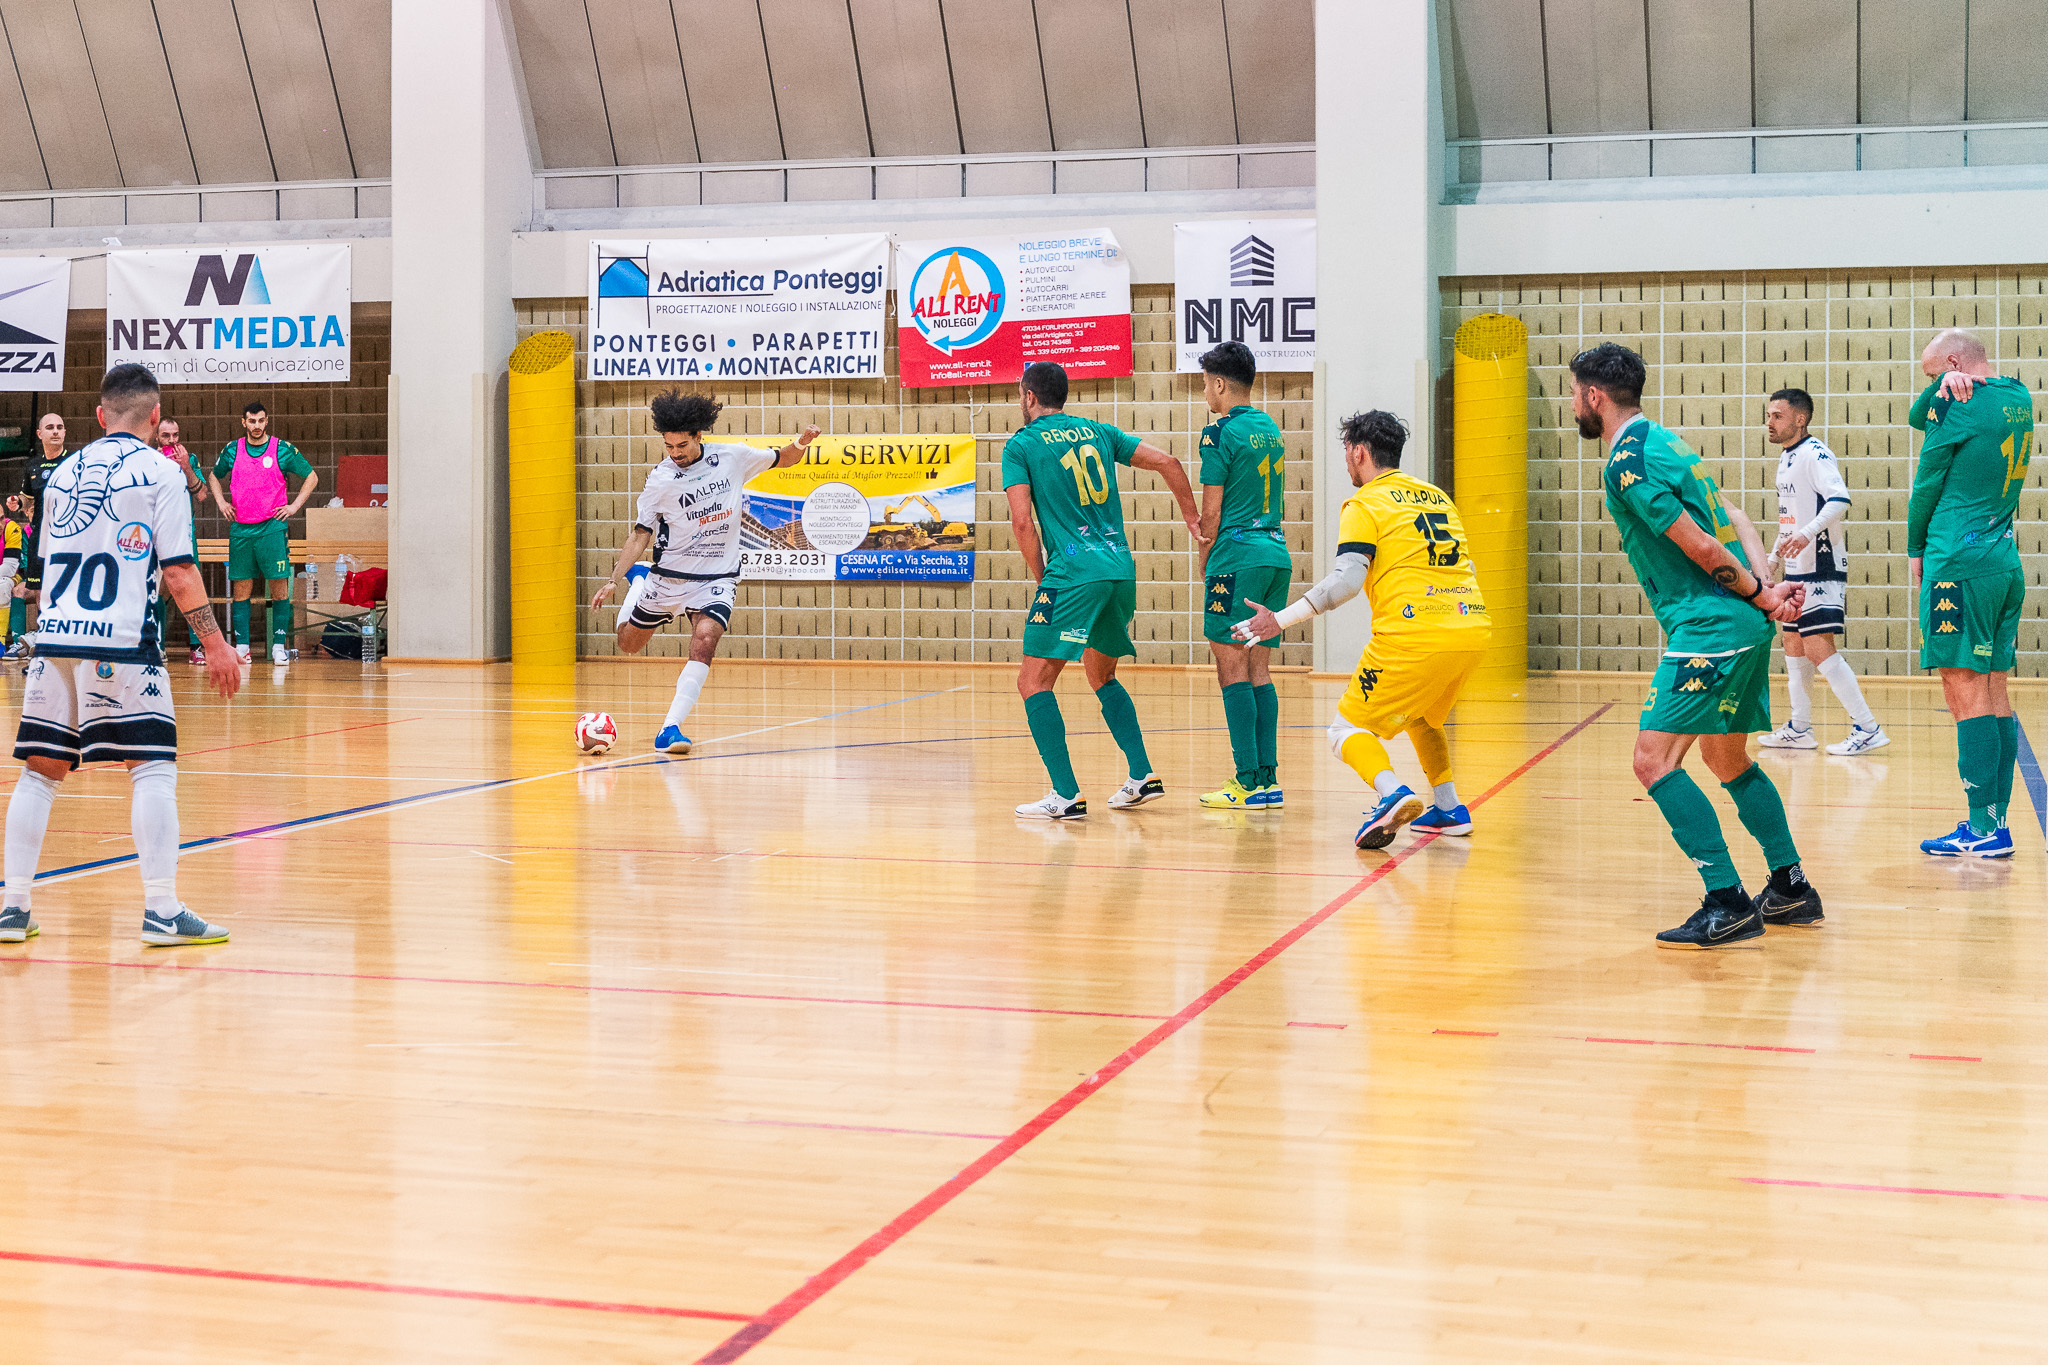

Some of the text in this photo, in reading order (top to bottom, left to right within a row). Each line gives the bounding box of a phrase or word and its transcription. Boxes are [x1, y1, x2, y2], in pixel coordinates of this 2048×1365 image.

[1018, 237, 1101, 251] NOLEGGIO BREVE
[1019, 248, 1118, 263] E LUNGO TERMINE DI:
[1025, 265, 1075, 275] AUTOVEICOLI
[657, 264, 883, 294] Adriatica Ponteggi
[1025, 275, 1056, 284] PULMINI
[1025, 284, 1069, 293] AUTOCARRI
[1026, 291, 1107, 303] PIATTAFORME AEREE
[656, 301, 737, 314] PROGETTAZIONE
[746, 301, 797, 313] NOLEGGIO
[805, 300, 882, 311] INSTALLAZIONE
[911, 291, 1001, 318] ALL RENT
[1026, 303, 1075, 313] GENERATORI
[933, 317, 977, 328] NOLEGGI
[1184, 296, 1316, 344] NMC
[112, 314, 345, 351] NEXTMEDIA
[1021, 324, 1041, 332] 47034
[593, 330, 878, 352] PONTEGGI PARAPETTI
[1037, 347, 1049, 355] 339
[183, 358, 198, 373] di
[205, 357, 345, 373] Comunicazione
[593, 355, 877, 376] LINEA VITA MONTACARICHI
[929, 360, 992, 370] www.all-rent.it
[930, 369, 991, 380] info@all-rent.it
[841, 443, 951, 466] SERVIZI
[2000, 431, 2034, 498] 14
[778, 469, 922, 482] Ottima Qualità al Miglior Prezzo!!!
[1060, 443, 1109, 506] 10
[695, 478, 731, 499] ALPHA
[1390, 490, 1406, 503] DI
[808, 521, 838, 529] NOLEGGIO
[820, 515, 852, 523] MONTAGGIO
[811, 533, 844, 541] MOVIMENTO
[818, 539, 853, 547] ESCAVAZIONE
[1413, 511, 1460, 567] 15
[841, 554, 969, 567] CESENA FC Via Secchia, 33
[851, 566, 968, 576] www.edilservizicesena.it
[47, 551, 120, 611] 70
